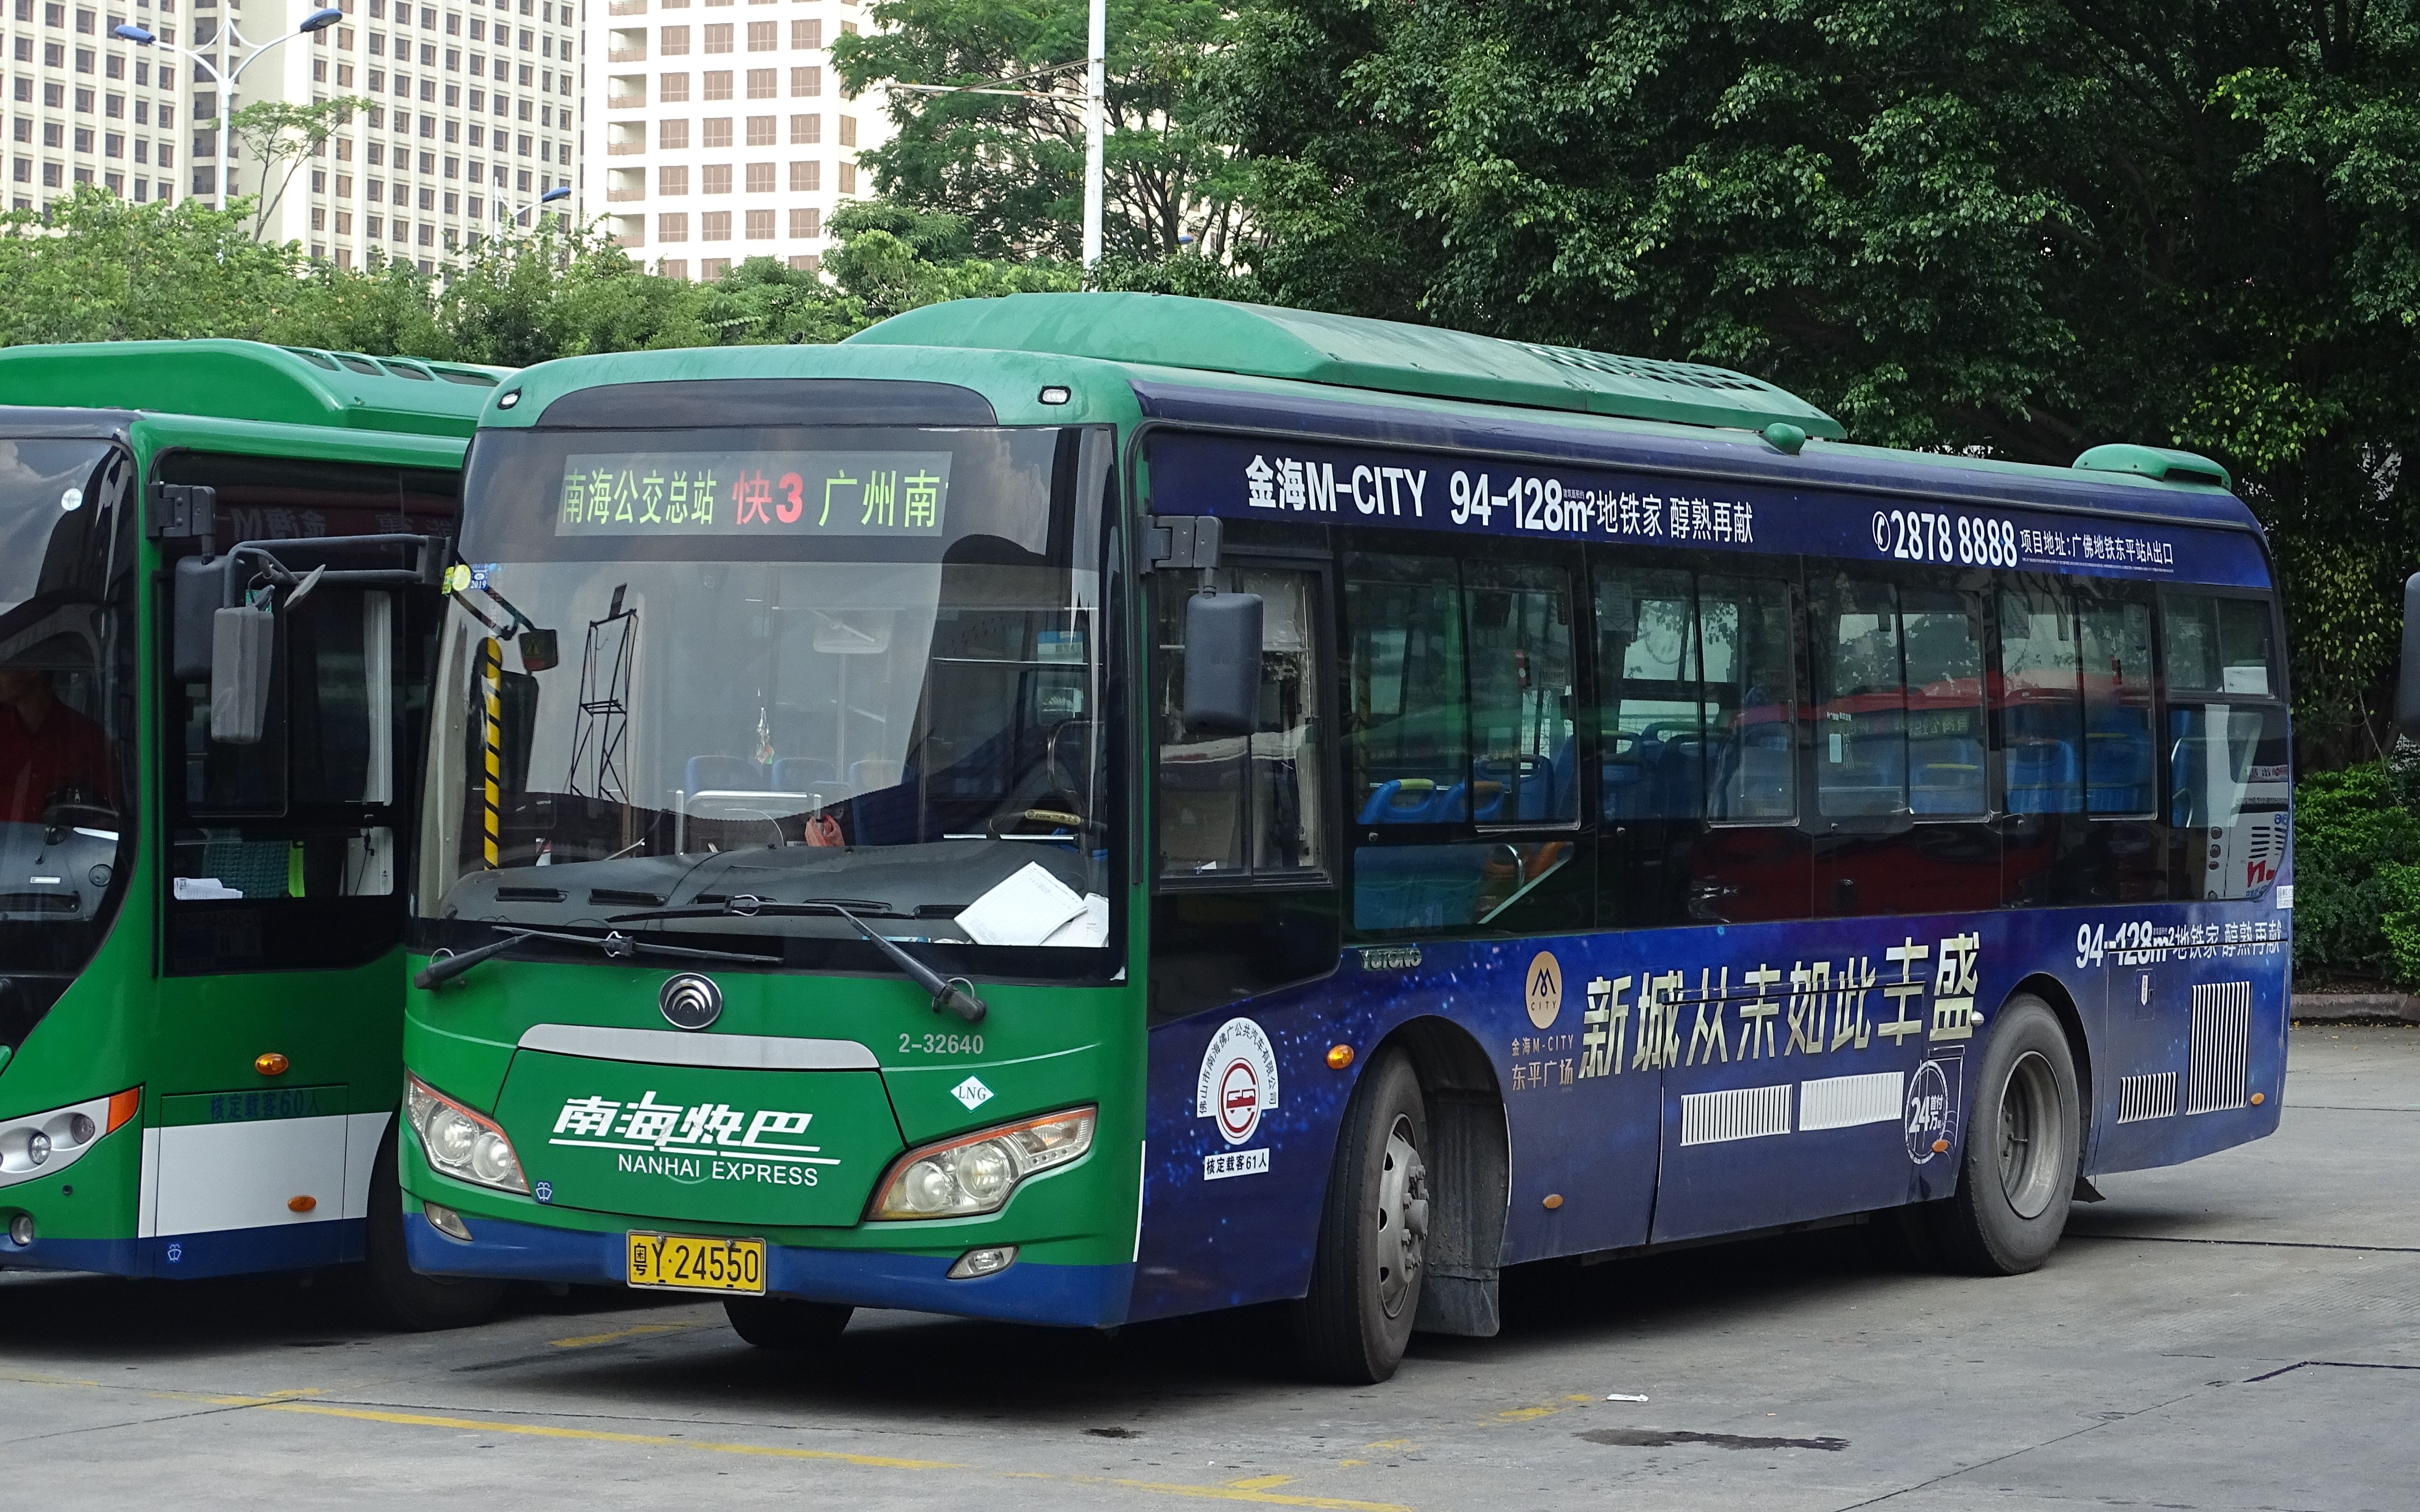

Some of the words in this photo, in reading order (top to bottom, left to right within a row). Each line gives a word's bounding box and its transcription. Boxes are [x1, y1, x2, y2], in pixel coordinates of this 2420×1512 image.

[563, 468, 717, 525] 南海公交总站
[732, 469, 803, 526] 快3
[818, 469, 948, 527] 广州南
[1245, 455, 1427, 517] 金海M-CITY
[1670, 497, 1753, 543] 醇熟再献
[1891, 510, 1953, 562] 2878
[1958, 516, 2017, 567] 8888
[470, 580, 486, 589] 2019
[2222, 919, 2282, 958] 醇熟再献
[1531, 1000, 1557, 1011] CITY
[1579, 932, 1979, 1078] 新城从未如此丰盛
[899, 1033, 984, 1054] 2-32640
[1199, 1022, 1277, 1114] 佛山市南海佛广公共汽车有限公司
[1512, 1058, 1574, 1091] 东平广场
[958, 1085, 986, 1100] LNG
[1930, 1094, 1943, 1111] 首付
[553, 1091, 821, 1152] 南海快巴
[1909, 1096, 1930, 1133] 24
[619, 1154, 700, 1177] NANHAI
[712, 1161, 818, 1187] EXPRESS
[1206, 1153, 1267, 1175] 核定载客61人
